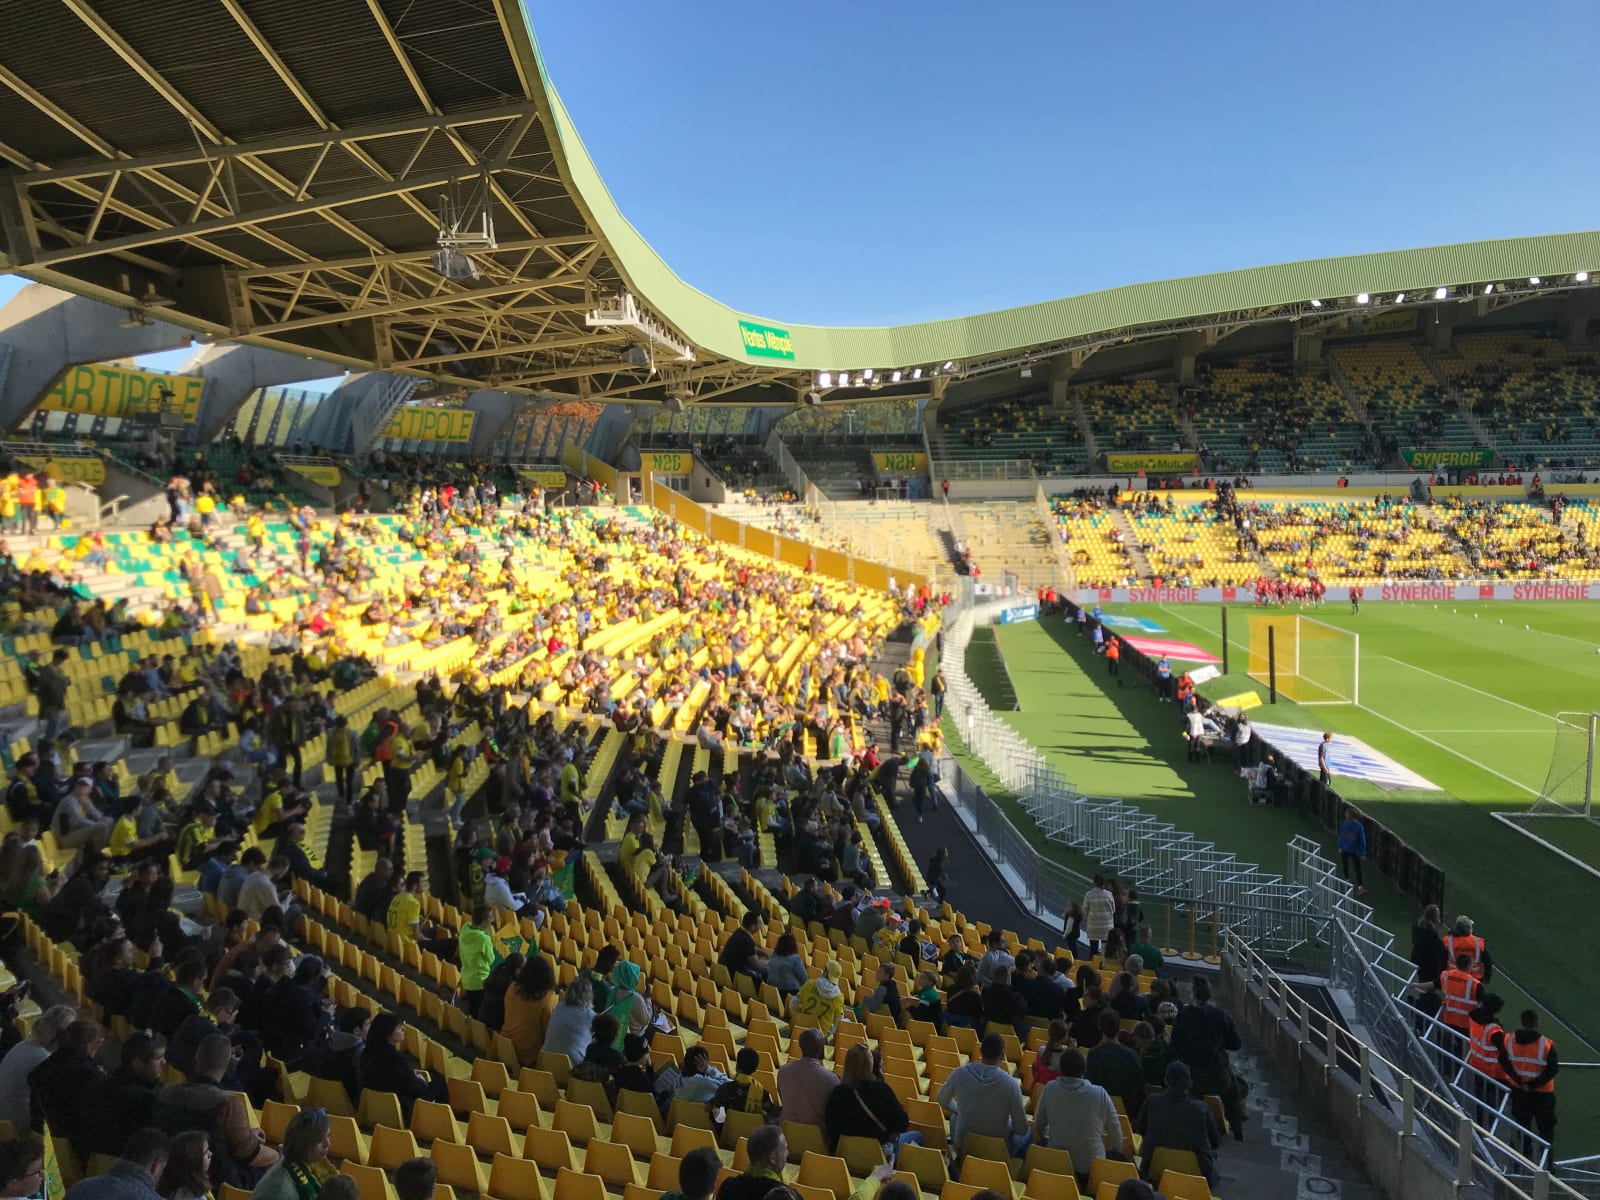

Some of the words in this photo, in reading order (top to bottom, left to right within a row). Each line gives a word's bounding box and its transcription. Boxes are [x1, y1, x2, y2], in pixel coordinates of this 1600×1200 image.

[741, 325, 767, 349] Nantes
[386, 408, 473, 440] RTIPOLE
[886, 454, 915, 471] N2H
[1157, 458, 1193, 469] Mutuel
[1413, 452, 1484, 466] SYNERGIE
[1129, 588, 1199, 602] SYNERGIE
[1381, 585, 1455, 600] SYNERGIE
[1513, 585, 1589, 600] SYNERGIE
[803, 996, 831, 1019] 27
